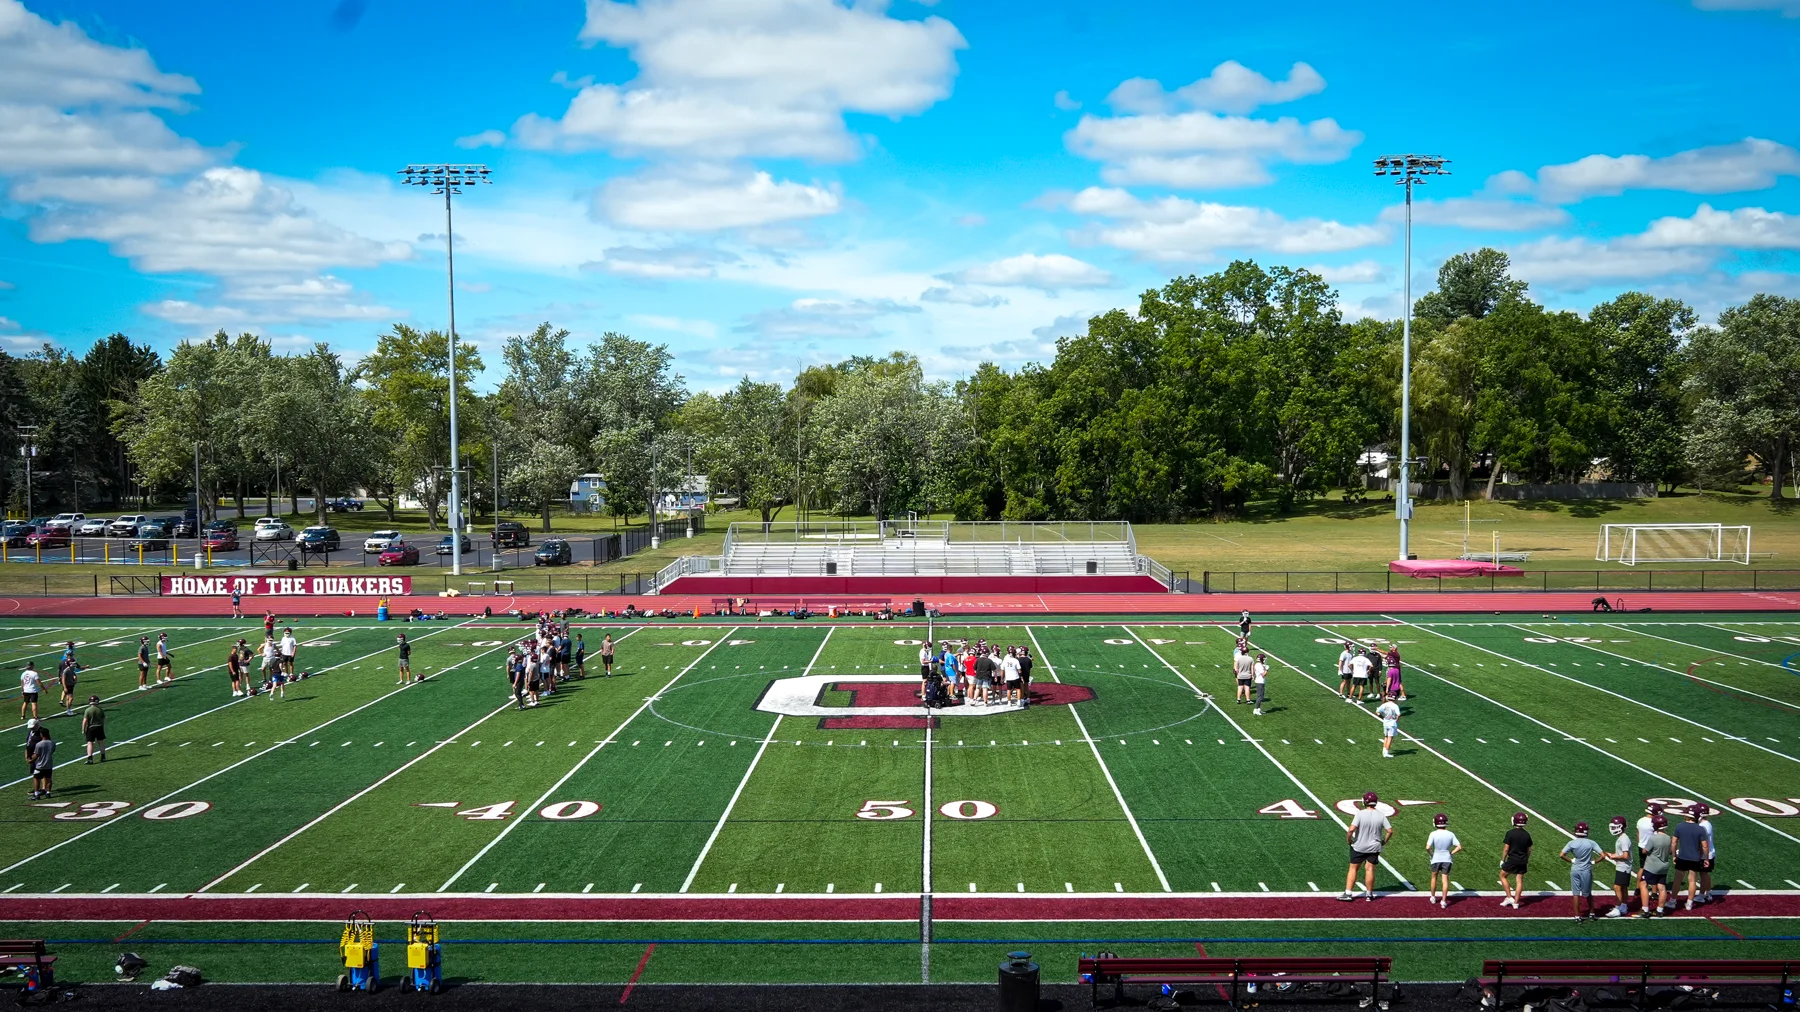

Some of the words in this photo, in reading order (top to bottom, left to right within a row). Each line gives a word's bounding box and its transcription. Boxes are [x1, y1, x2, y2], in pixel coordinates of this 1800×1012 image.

[170, 577, 227, 594] HOME
[233, 577, 258, 594] OF
[266, 577, 308, 594] THE
[312, 577, 403, 595] QUAKERS
